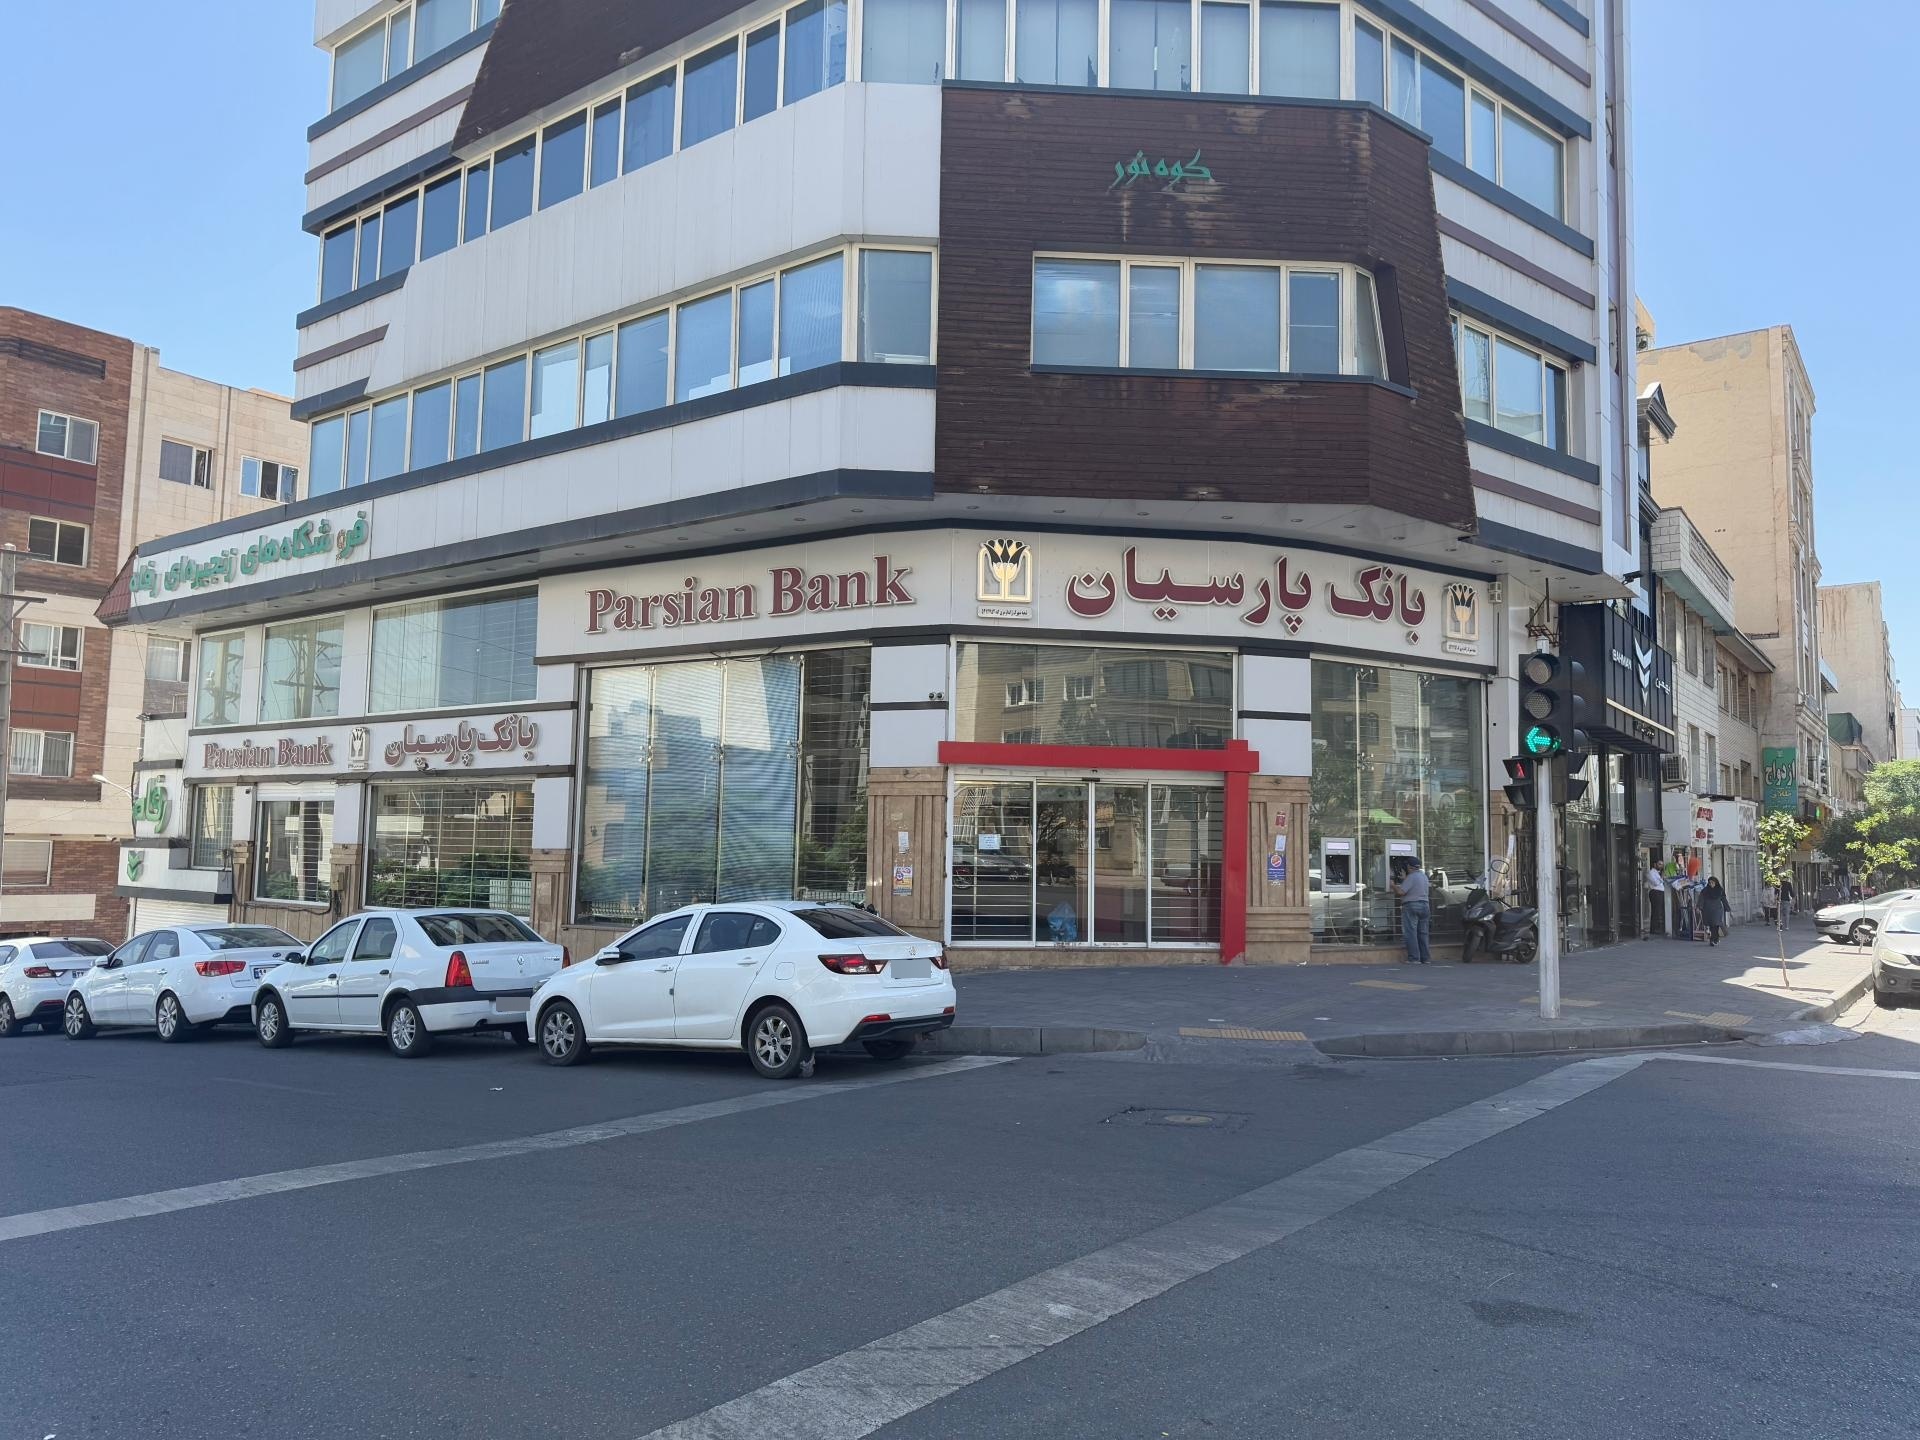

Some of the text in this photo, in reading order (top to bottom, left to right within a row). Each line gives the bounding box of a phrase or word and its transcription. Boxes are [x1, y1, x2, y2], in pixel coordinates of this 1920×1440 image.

[1105, 148, 1216, 196] کوه نور
[129, 560, 162, 598] رفاه
[584, 554, 916, 634] Parsian Bank
[1065, 544, 1426, 644] بانک پارسیان
[203, 736, 333, 769] Parsian Bank
[384, 713, 539, 769] بانک پارسیان
[1764, 759, 1796, 786] ازدواج
[132, 775, 172, 834] رفاه
